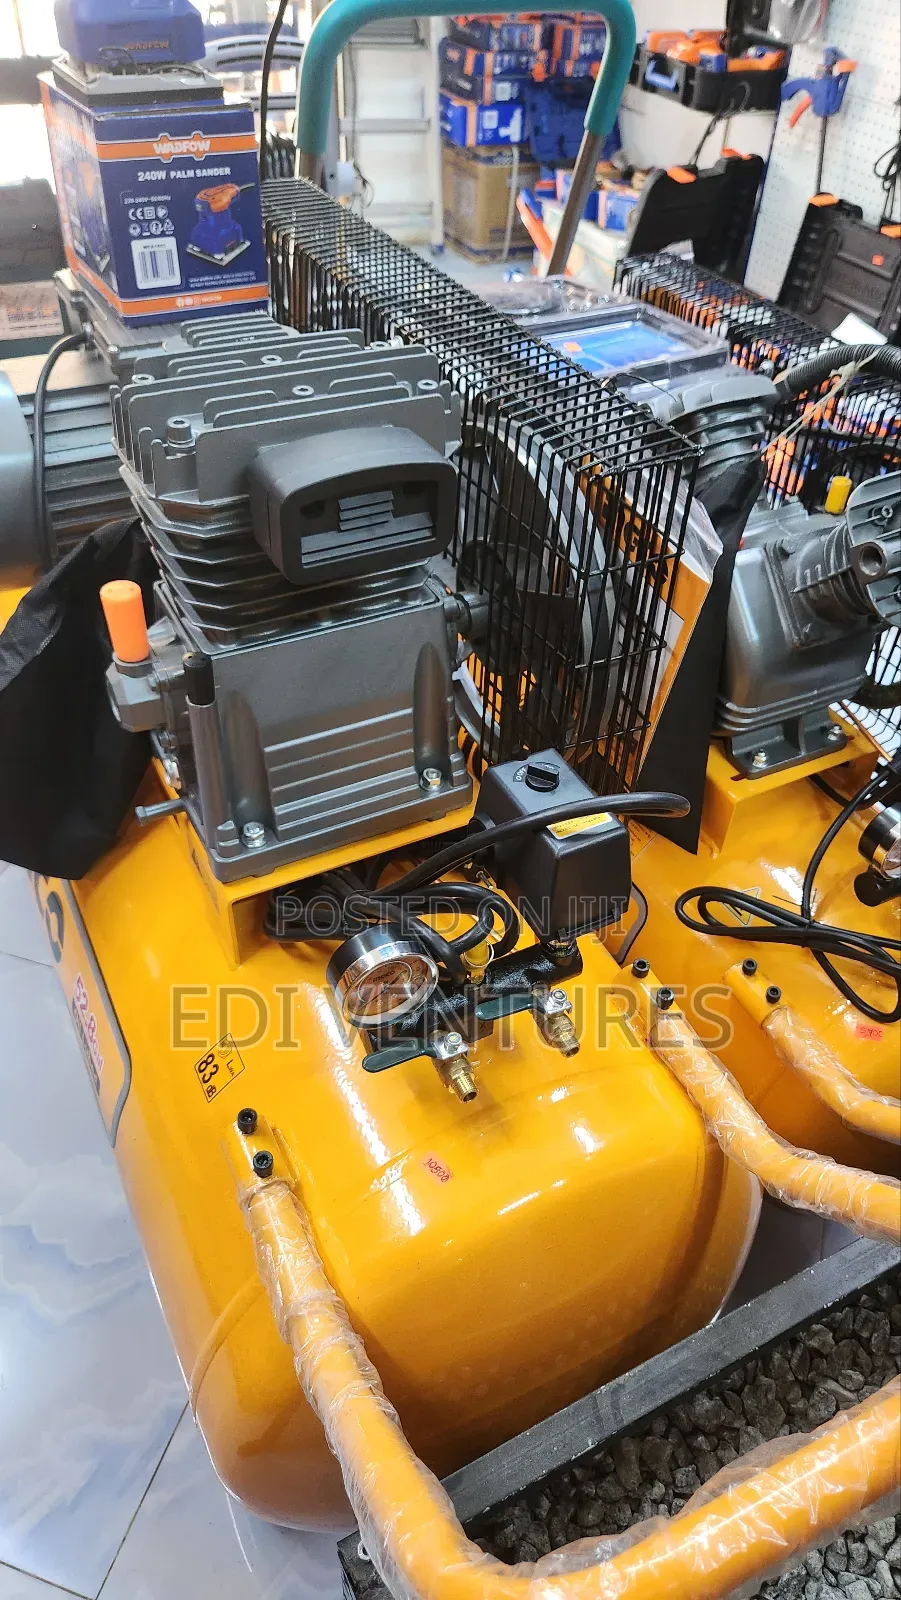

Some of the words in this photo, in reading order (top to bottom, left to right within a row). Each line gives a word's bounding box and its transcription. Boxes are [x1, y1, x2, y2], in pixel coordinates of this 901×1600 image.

[153, 139, 210, 154] WADFOW
[137, 170, 166, 182] 240W
[170, 169, 194, 180] PALM
[196, 167, 231, 178] SANDER
[197, 1053, 219, 1084] 83
